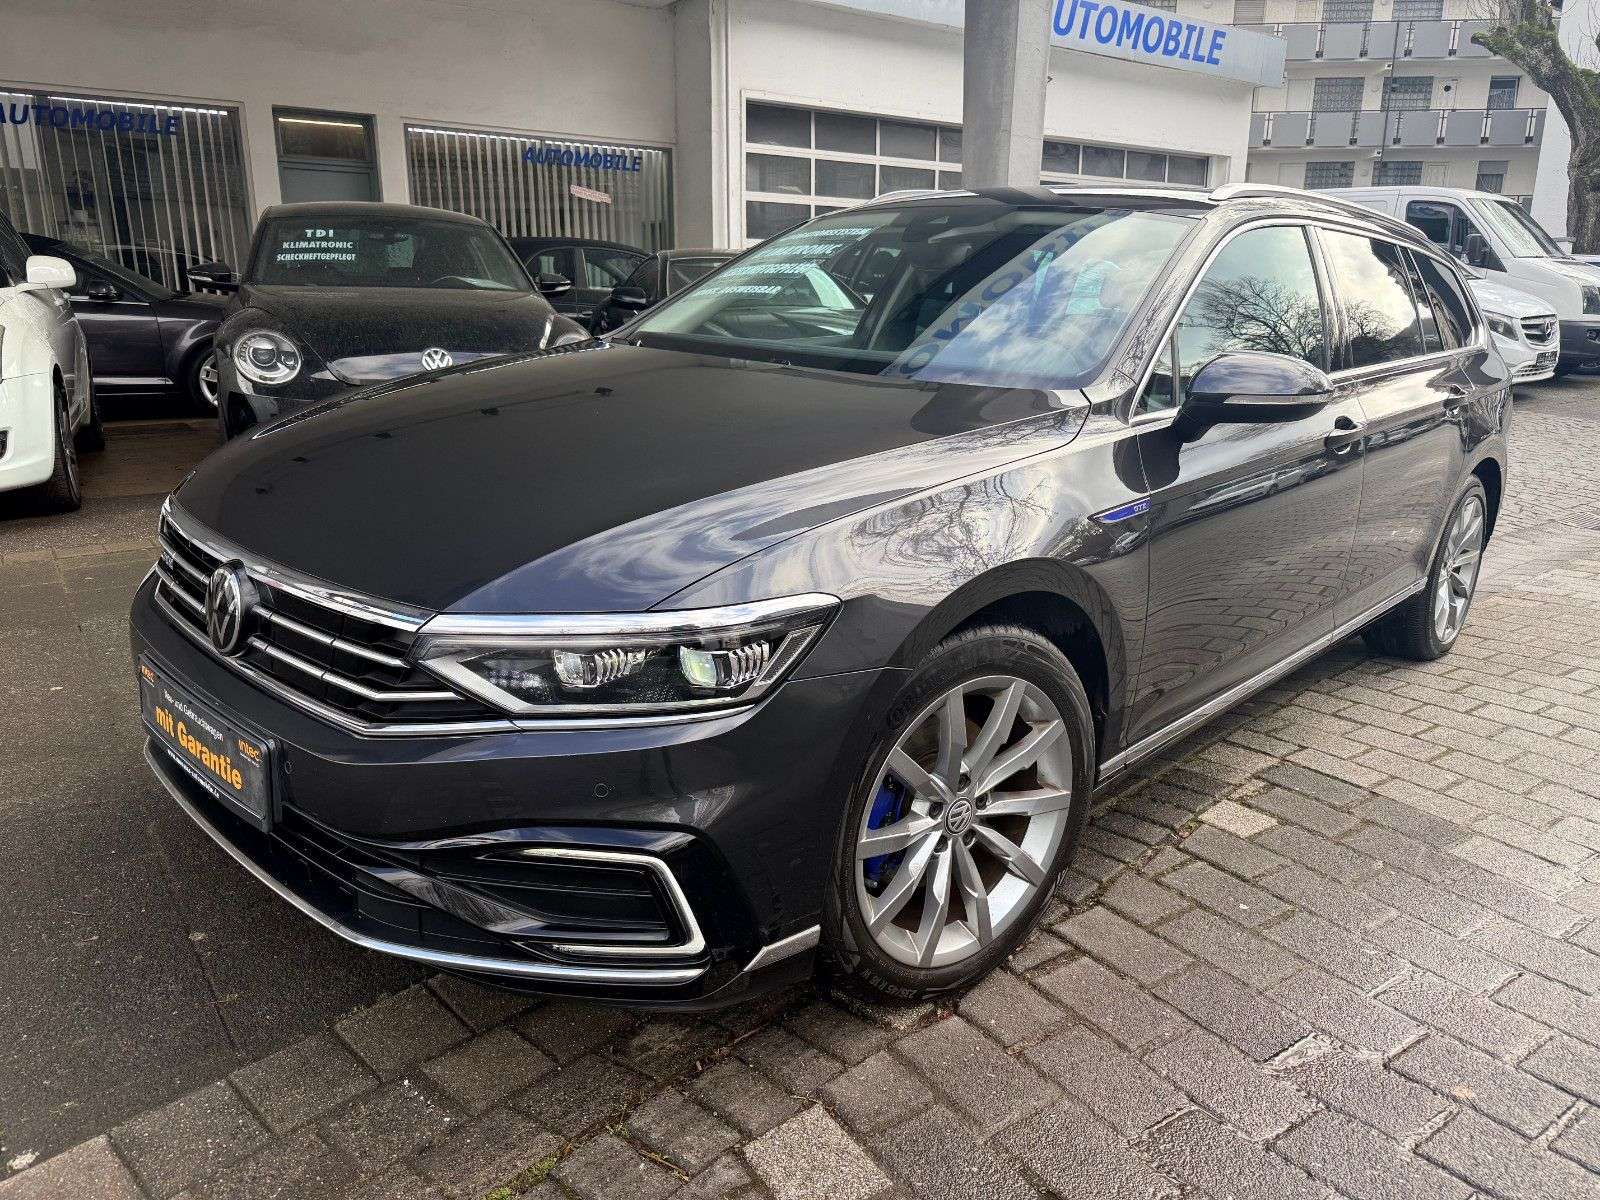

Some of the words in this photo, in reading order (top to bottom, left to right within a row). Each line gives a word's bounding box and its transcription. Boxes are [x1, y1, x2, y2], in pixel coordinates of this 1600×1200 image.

[522, 146, 643, 172] AUTOMOBILE
[305, 229, 334, 238] TDI
[282, 241, 354, 249] KLIMATRONIC
[276, 252, 356, 261] SCHECKHEFTGEPFLEGT
[155, 705, 175, 738] mit
[177, 720, 243, 790] Garantie
